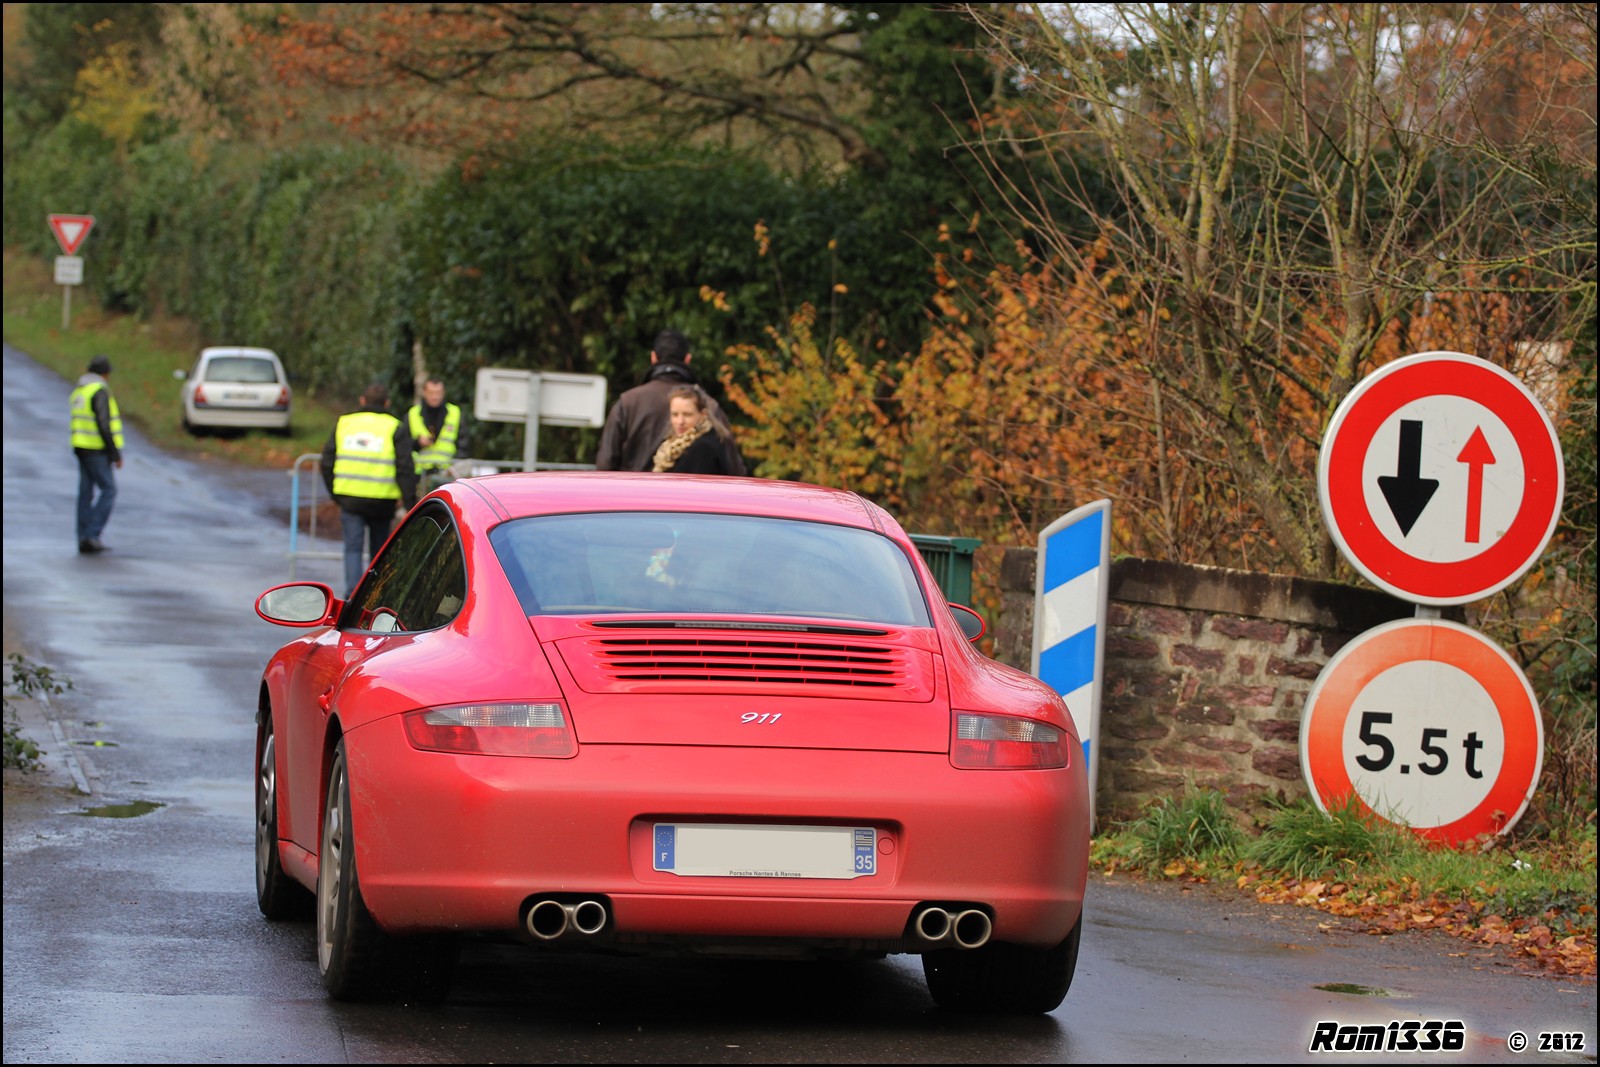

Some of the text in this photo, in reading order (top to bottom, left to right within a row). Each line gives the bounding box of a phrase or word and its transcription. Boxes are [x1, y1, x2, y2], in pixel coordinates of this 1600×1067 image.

[741, 712, 782, 724] 911
[1355, 711, 1484, 779] 5.5 t
[661, 852, 668, 862] F
[855, 855, 873, 870] 35
